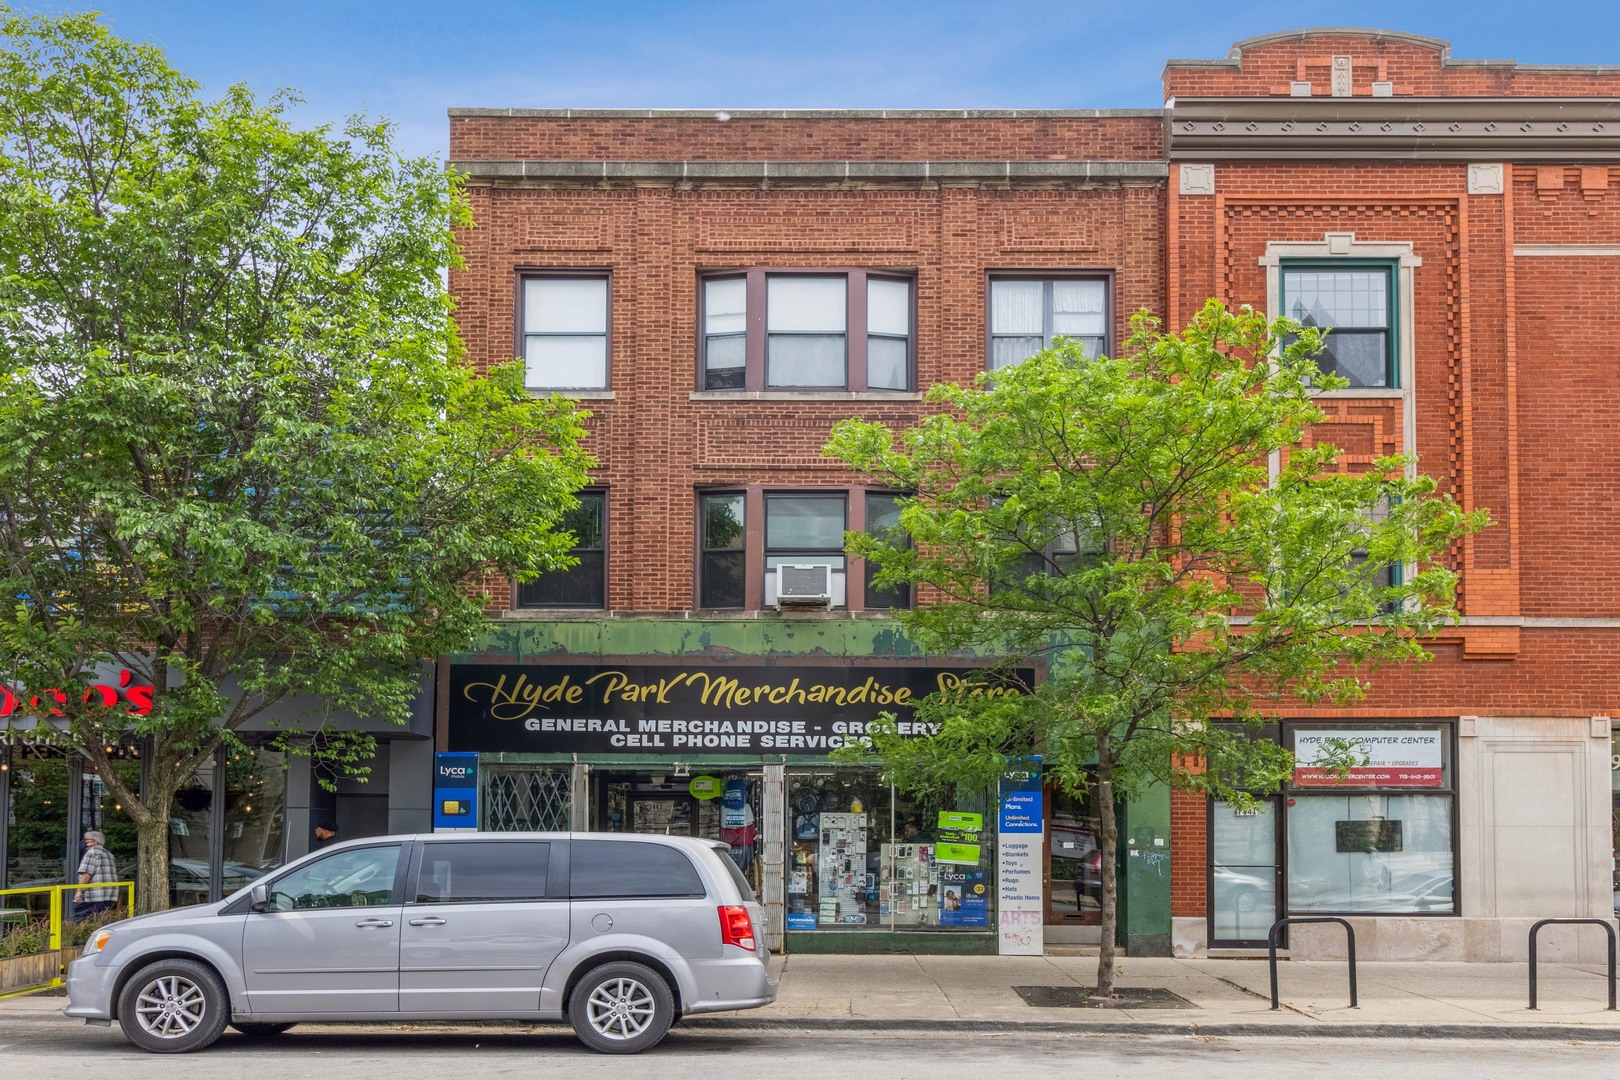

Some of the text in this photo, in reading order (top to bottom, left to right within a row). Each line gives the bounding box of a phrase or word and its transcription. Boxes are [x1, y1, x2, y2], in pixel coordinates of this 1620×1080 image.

[463, 674, 583, 720] Hyde
[585, 671, 687, 704] Park
[685, 672, 912, 710] Merchandise
[524, 718, 631, 732] GENERAL
[638, 719, 806, 734] MERCHANDISE
[610, 734, 665, 747] CELL
[673, 734, 750, 748] PHONE
[1299, 736, 1321, 744] HYDE
[1350, 736, 1399, 744] COMPUTER
[1400, 736, 1436, 744] CENTER
[440, 765, 466, 776] Lyca
[944, 872, 966, 881] Lyca
